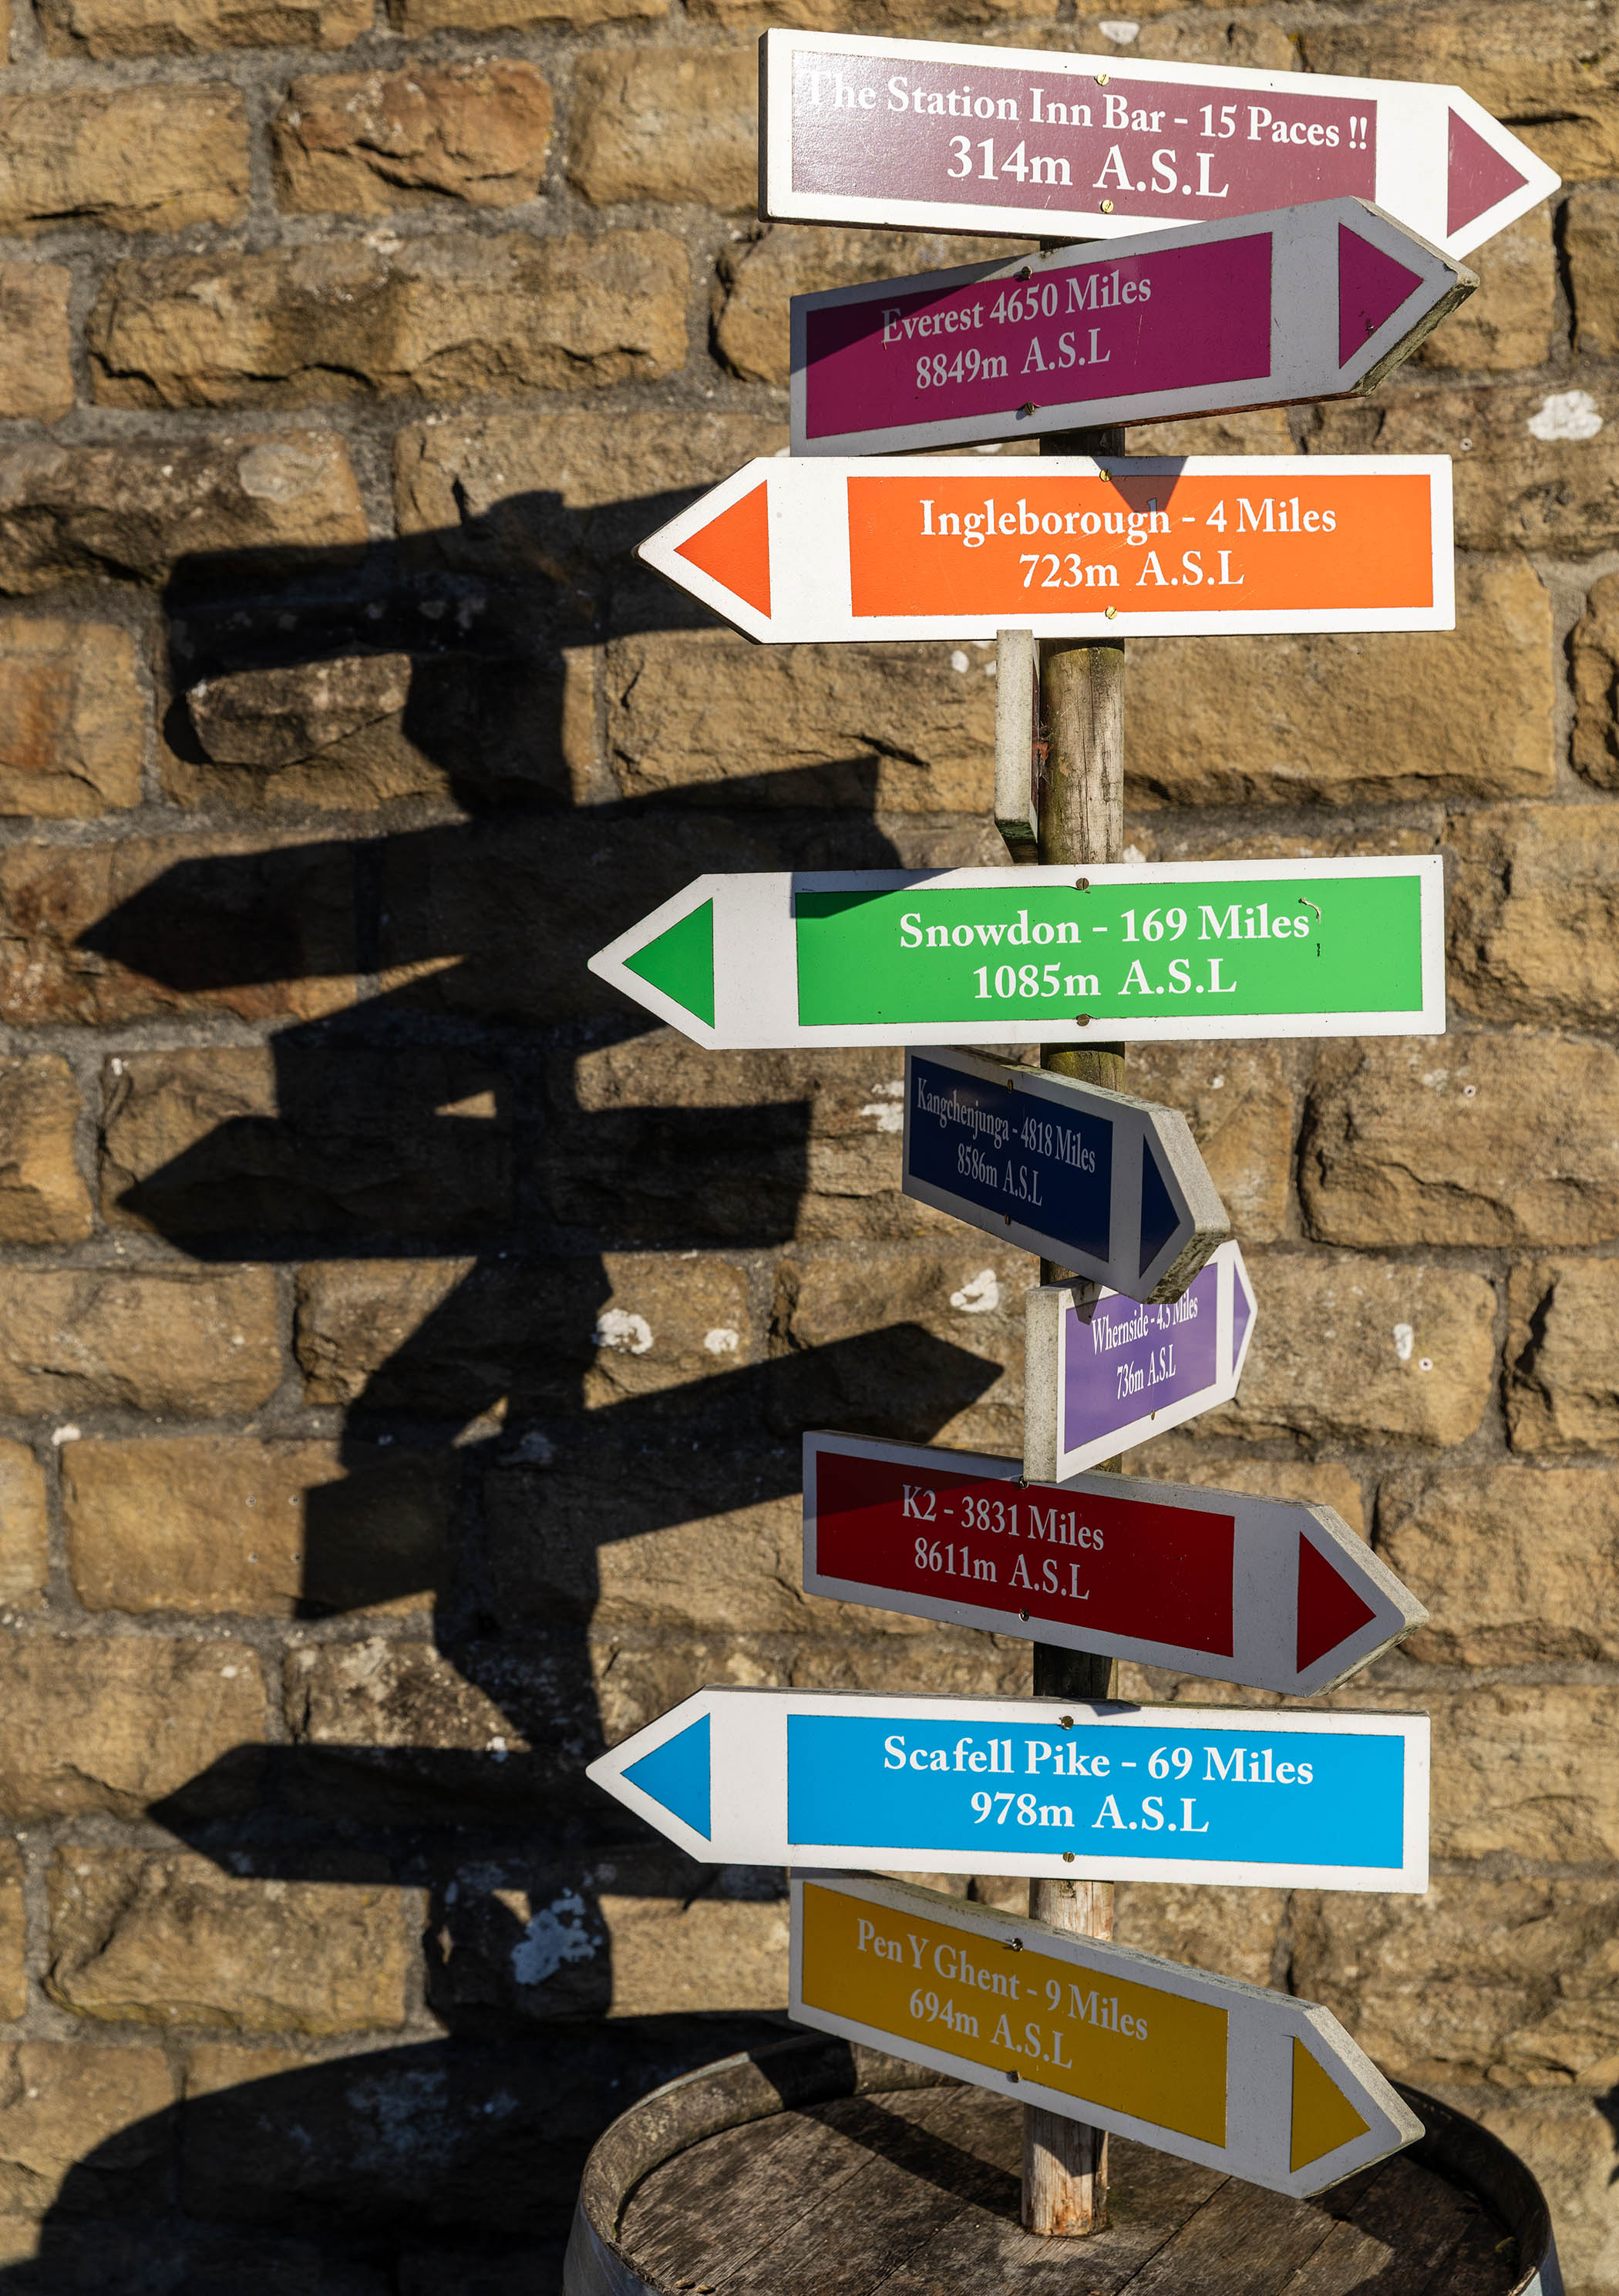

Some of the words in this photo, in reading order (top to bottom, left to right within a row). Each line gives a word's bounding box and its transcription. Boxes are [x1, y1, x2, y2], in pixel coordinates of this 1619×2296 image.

[802, 69, 877, 110] The
[887, 76, 1019, 121] Station
[1030, 88, 1092, 126] Inn
[1102, 94, 1165, 132] Bar
[1200, 105, 1237, 138] 15
[1247, 106, 1339, 146] Paces
[1350, 116, 1367, 150] !!
[948, 136, 1072, 185] 314m
[1092, 145, 1228, 197] A.S.L
[883, 303, 984, 344] Everest
[990, 284, 1058, 324] 4650
[1065, 269, 1151, 313] Miles
[917, 349, 1008, 388] 8849m
[1021, 328, 1110, 374] A.S.L
[920, 498, 1172, 548] Ingleborough
[1206, 500, 1227, 532] 4
[1237, 497, 1336, 532] Miles
[1020, 553, 1119, 587] 723m
[1136, 550, 1244, 586] A.S.L
[900, 909, 1082, 947] Snowdon
[1121, 908, 1187, 941] 169
[1197, 904, 1309, 940] Miles
[974, 962, 1101, 998] 1085m
[1118, 959, 1237, 994] A.S.L
[917, 1077, 1010, 1149] Kangchenjunga
[1021, 1118, 1052, 1156] 4818
[1055, 1125, 1096, 1174] Miles
[958, 1143, 998, 1188] 8586m
[1003, 1159, 1042, 1207] A.S.L
[1092, 1304, 1148, 1354] Whernside
[1173, 1289, 1198, 1326] Miles
[1117, 1361, 1143, 1400] 736m
[1147, 1344, 1176, 1386] A.S.L
[903, 1484, 937, 1521] K2
[961, 1495, 1021, 1537] 3831
[1028, 1505, 1103, 1550] Miles
[915, 1538, 997, 1582] 8611m
[1008, 1554, 1089, 1599] A.S.L
[884, 1736, 1014, 1773] Scafell
[1025, 1741, 1110, 1777] Pike
[1149, 1747, 1192, 1780] 69
[1203, 1747, 1313, 1784] Miles
[971, 1792, 1075, 1827] 978m
[1092, 1794, 1209, 1832] A.S.L
[857, 1918, 903, 1963] Pen
[907, 1934, 930, 1969] Y
[934, 1944, 1019, 2001] Ghent
[1046, 1979, 1061, 2010] 9
[1068, 1984, 1147, 2040] Miles
[910, 1989, 979, 2038] 694m
[990, 2013, 1072, 2070] A.S.L
